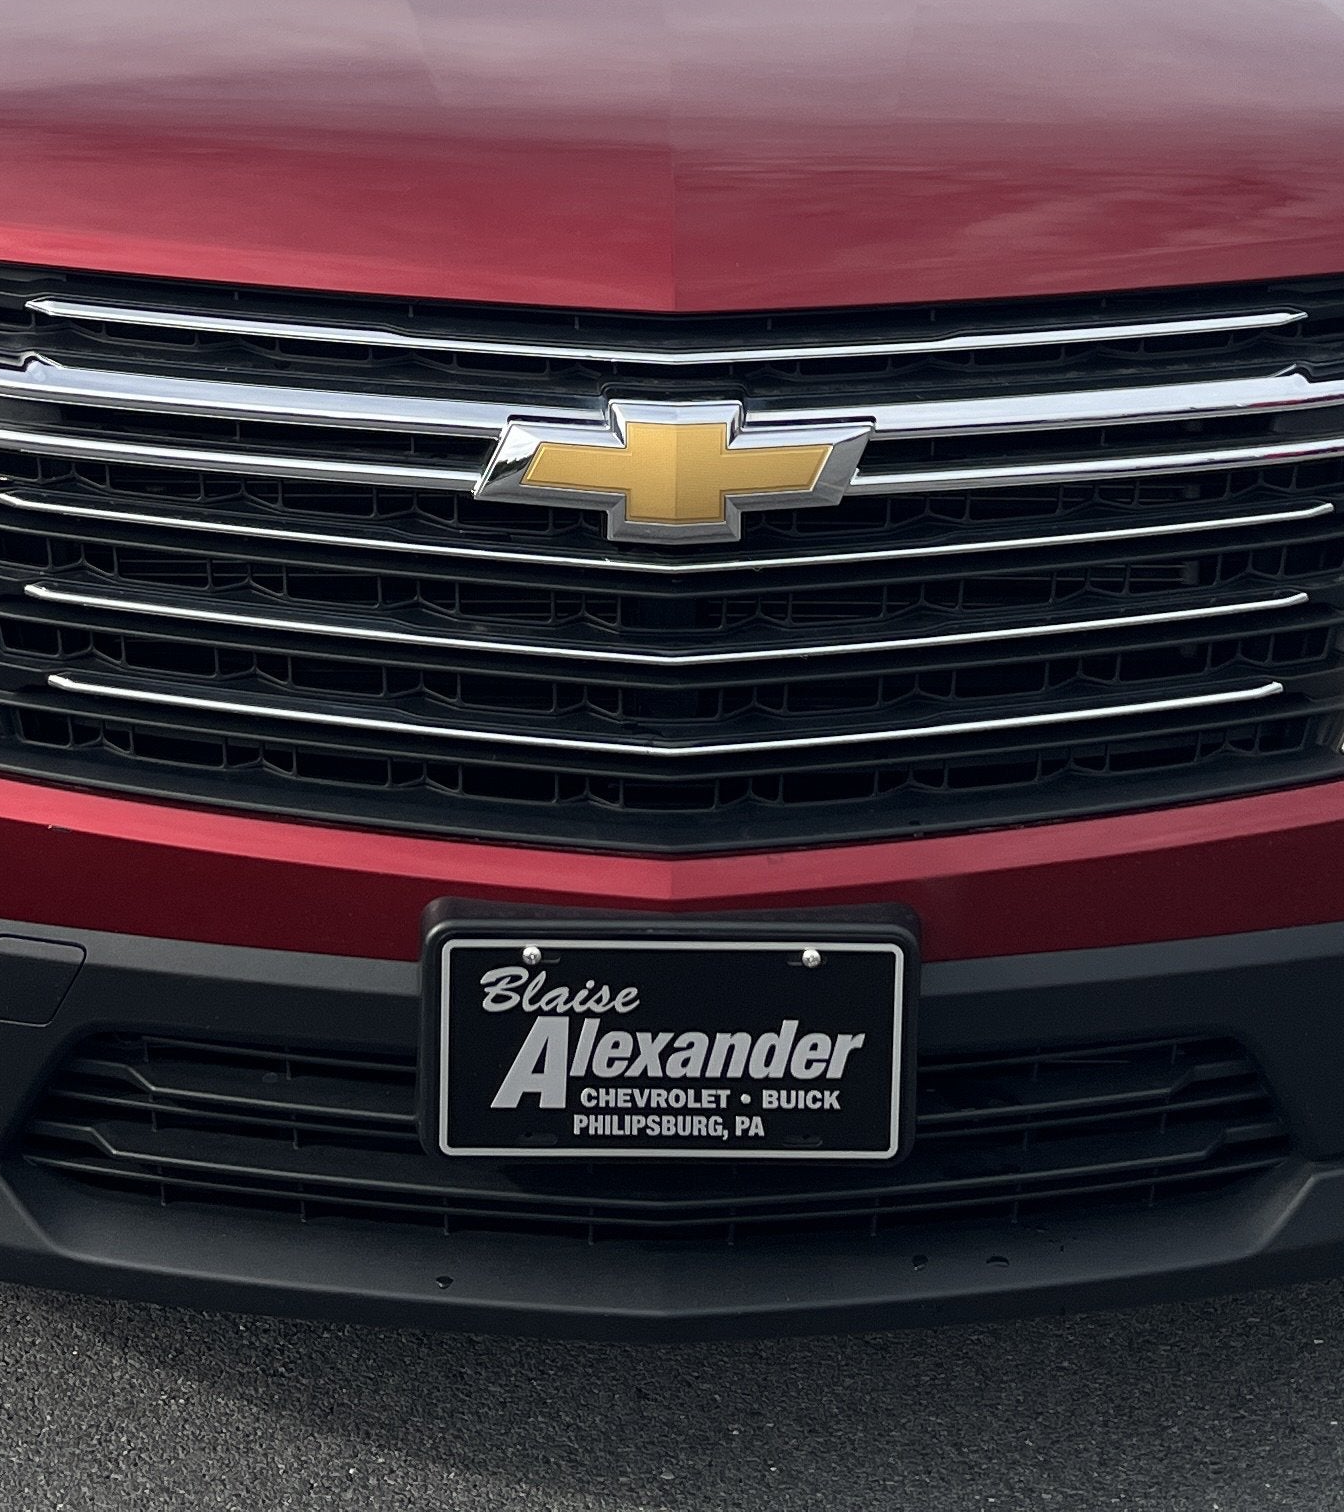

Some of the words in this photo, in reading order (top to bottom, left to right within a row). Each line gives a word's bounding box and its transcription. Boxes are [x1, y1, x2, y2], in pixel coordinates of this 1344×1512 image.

[479, 966, 641, 1014] Blaise
[490, 1015, 866, 1109] Alexander
[580, 1088, 731, 1109] CHEVROLET
[761, 1089, 841, 1110] BUICK
[573, 1114, 730, 1141] PHILIPSBURG,
[735, 1115, 765, 1138] PA
